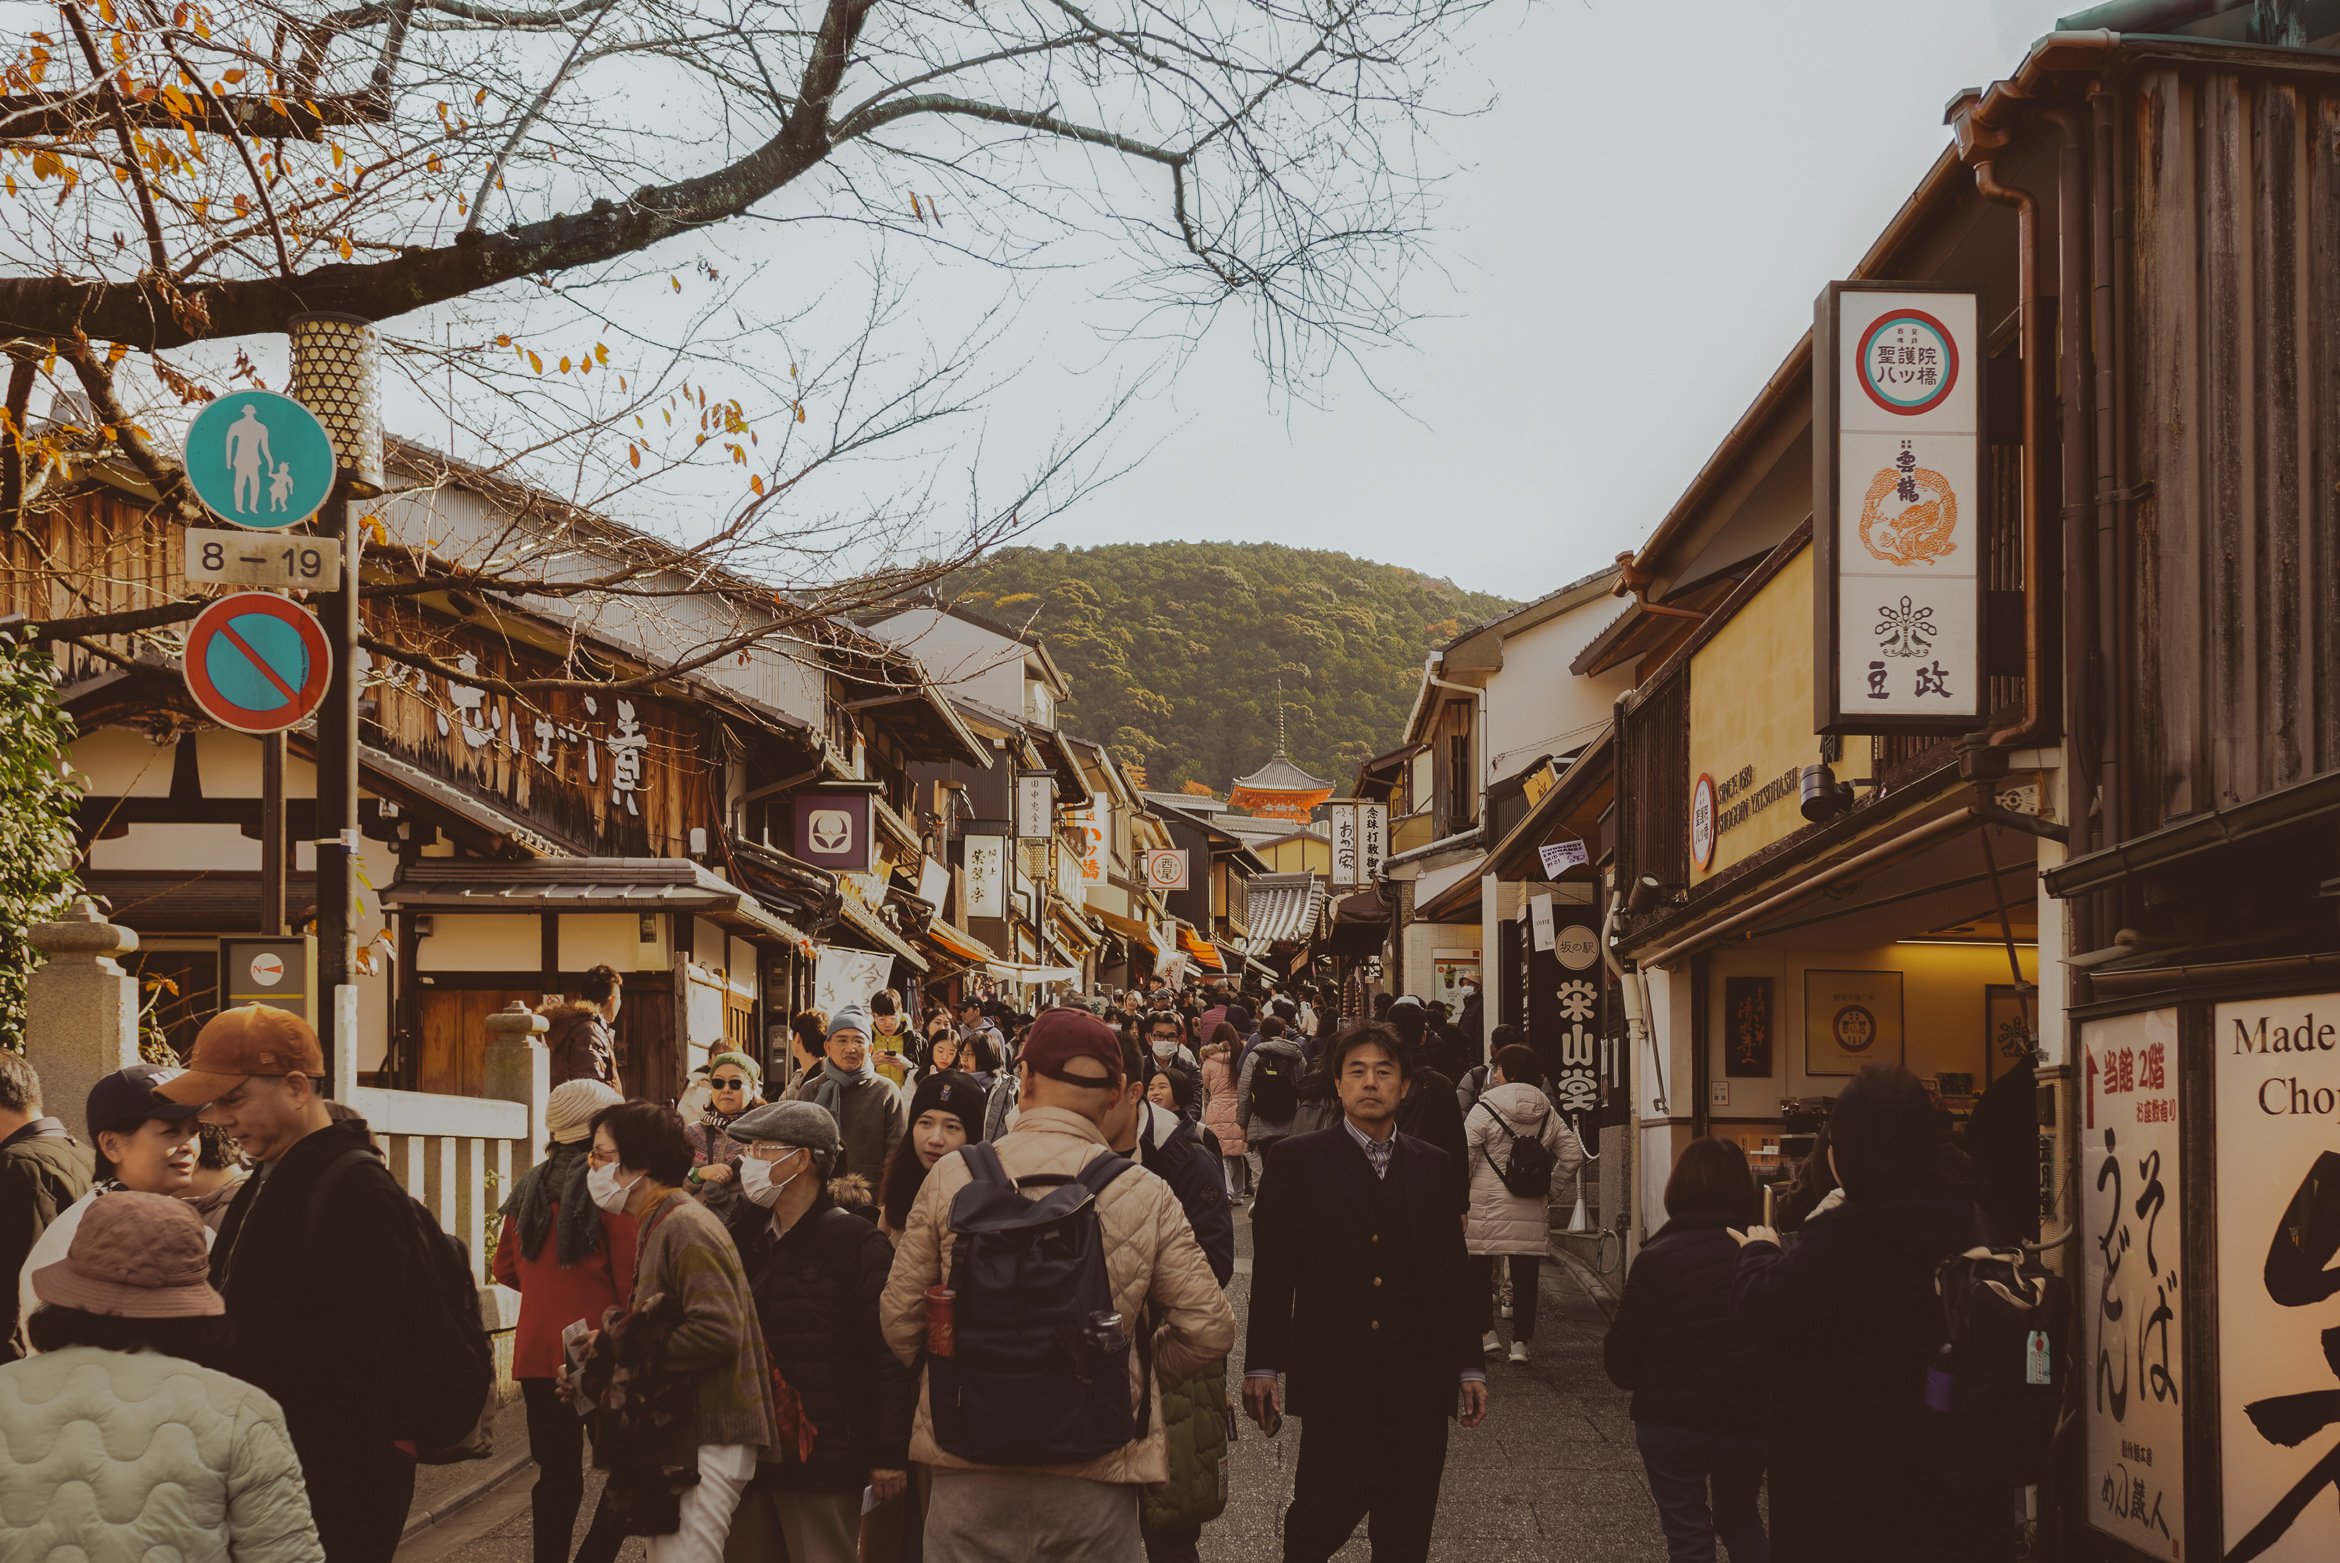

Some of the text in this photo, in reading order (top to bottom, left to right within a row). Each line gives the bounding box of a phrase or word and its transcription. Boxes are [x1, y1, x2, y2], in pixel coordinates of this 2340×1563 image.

[1876, 366, 1938, 386] 八ツ橋
[1877, 345, 1938, 366] 聖護院
[1896, 450, 1920, 503] 雲龍
[1866, 660, 1954, 700] 豆政
[1717, 774, 1739, 806] SINCE
[1717, 765, 1799, 836] SHOGOIN YATSUHASHI
[1160, 857, 1174, 881] 西尾
[1559, 941, 1596, 954] 坂の駅
[1556, 979, 1598, 1112] 栄山堂
[2231, 1013, 2336, 1056] Made
[2103, 1041, 2166, 1095] 当館 2階
[2096, 1127, 2131, 1423] うどん
[2135, 1149, 2179, 1406] そば
